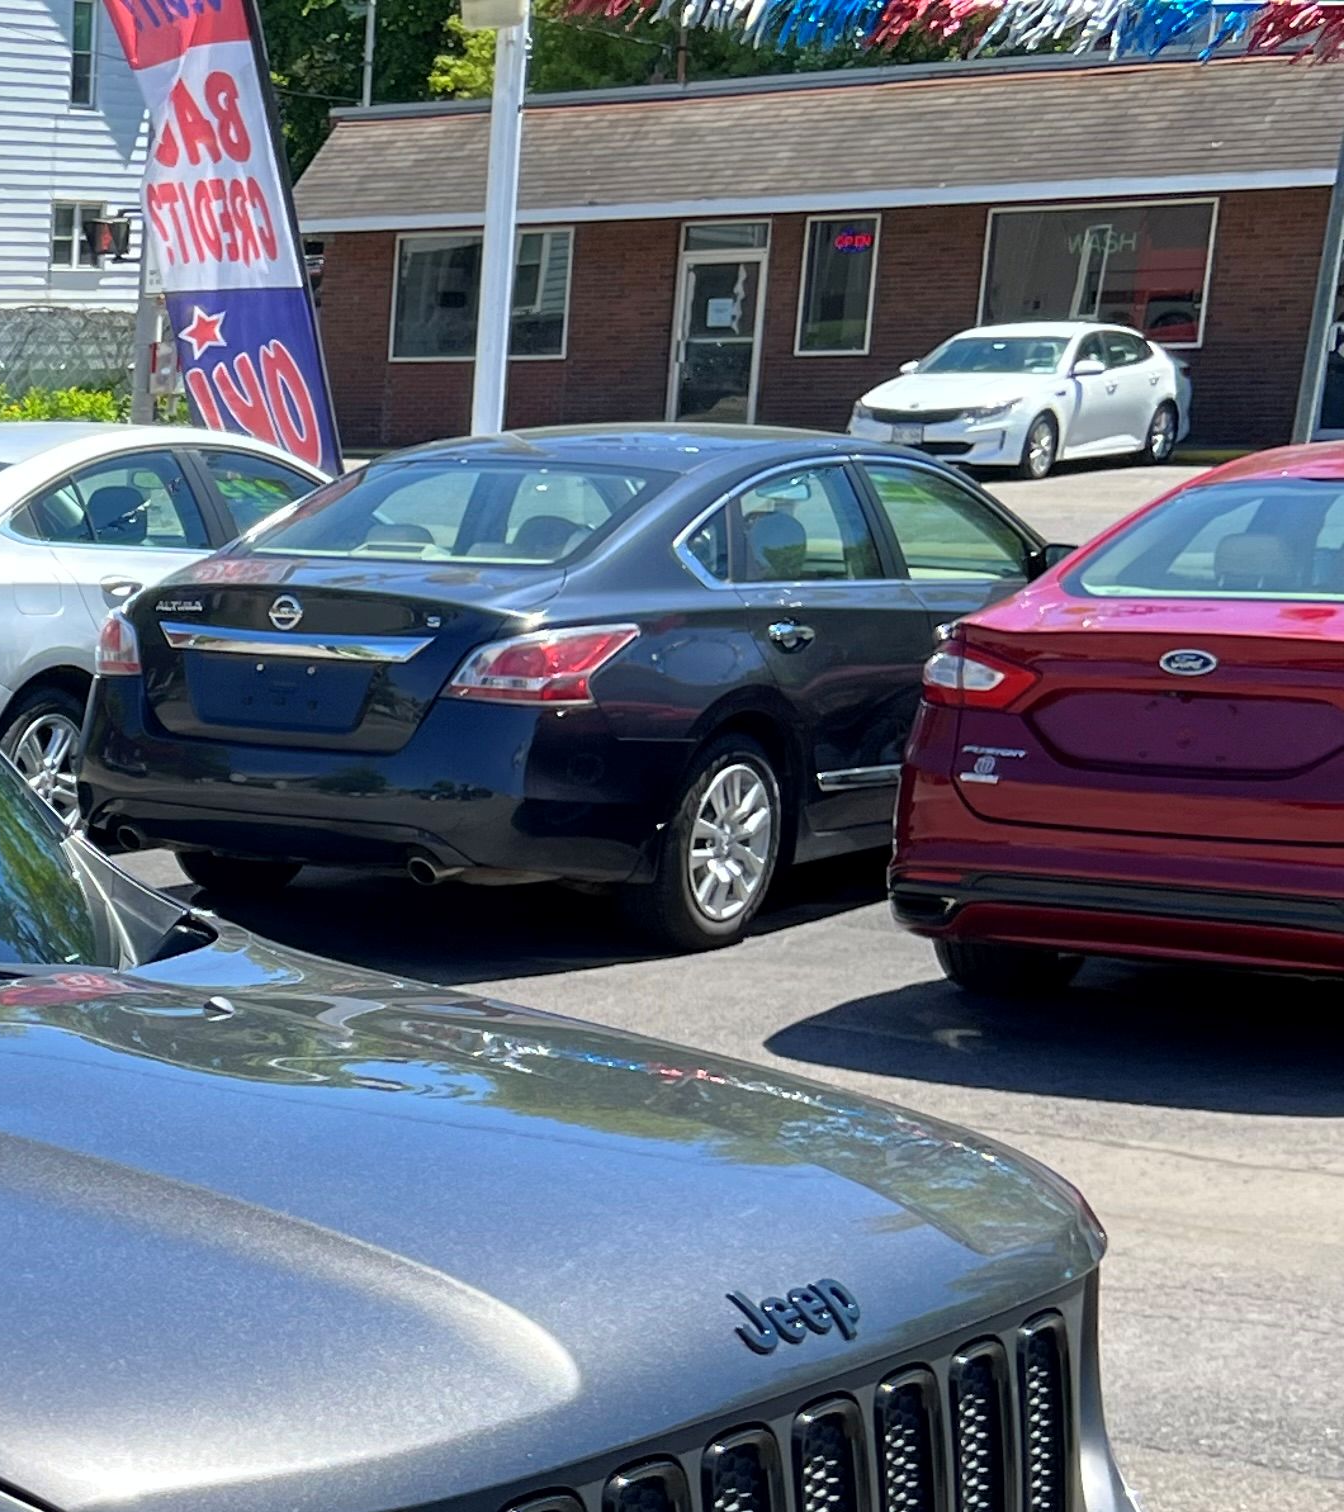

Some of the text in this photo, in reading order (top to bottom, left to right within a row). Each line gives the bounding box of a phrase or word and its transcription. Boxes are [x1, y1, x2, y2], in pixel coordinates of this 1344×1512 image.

[834, 233, 872, 250] OPEN
[1068, 231, 1137, 255] WASH
[725, 1278, 860, 1355] Jeep
